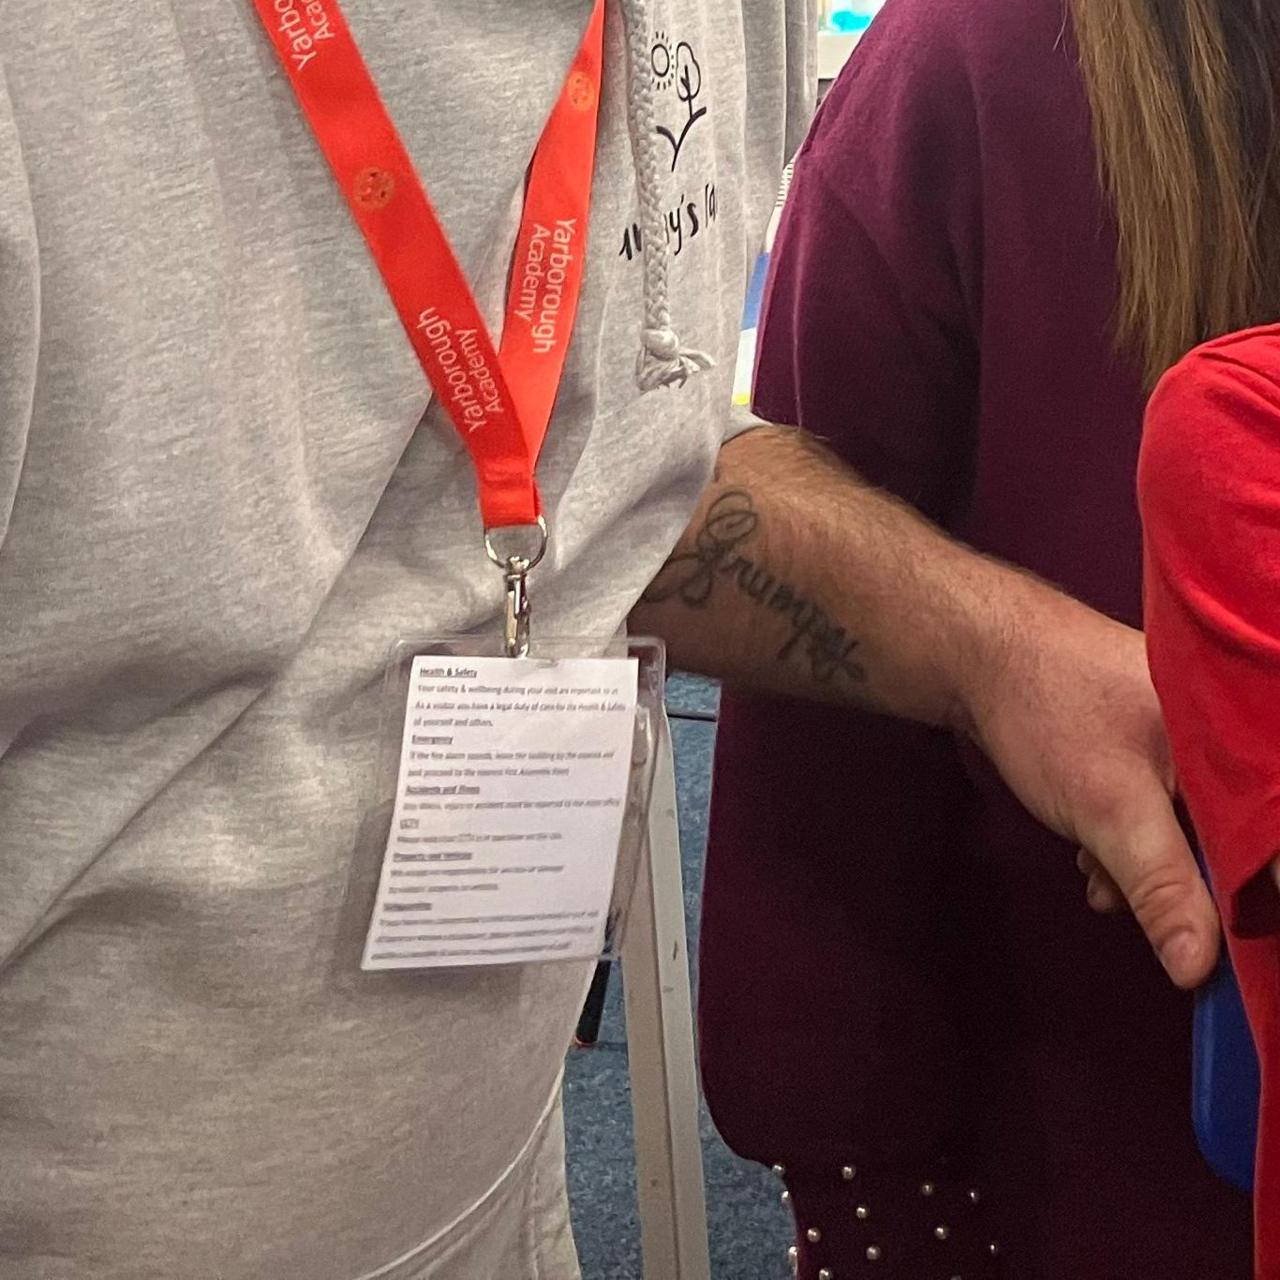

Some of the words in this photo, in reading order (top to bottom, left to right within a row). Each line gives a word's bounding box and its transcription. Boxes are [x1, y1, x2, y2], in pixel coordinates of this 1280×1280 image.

[511, 223, 552, 322] Academy
[531, 217, 577, 354] Yarborough
[418, 306, 486, 433] Yarborough
[455, 327, 505, 412] Academy
[420, 667, 445, 677] Health
[455, 667, 477, 679] Safety
